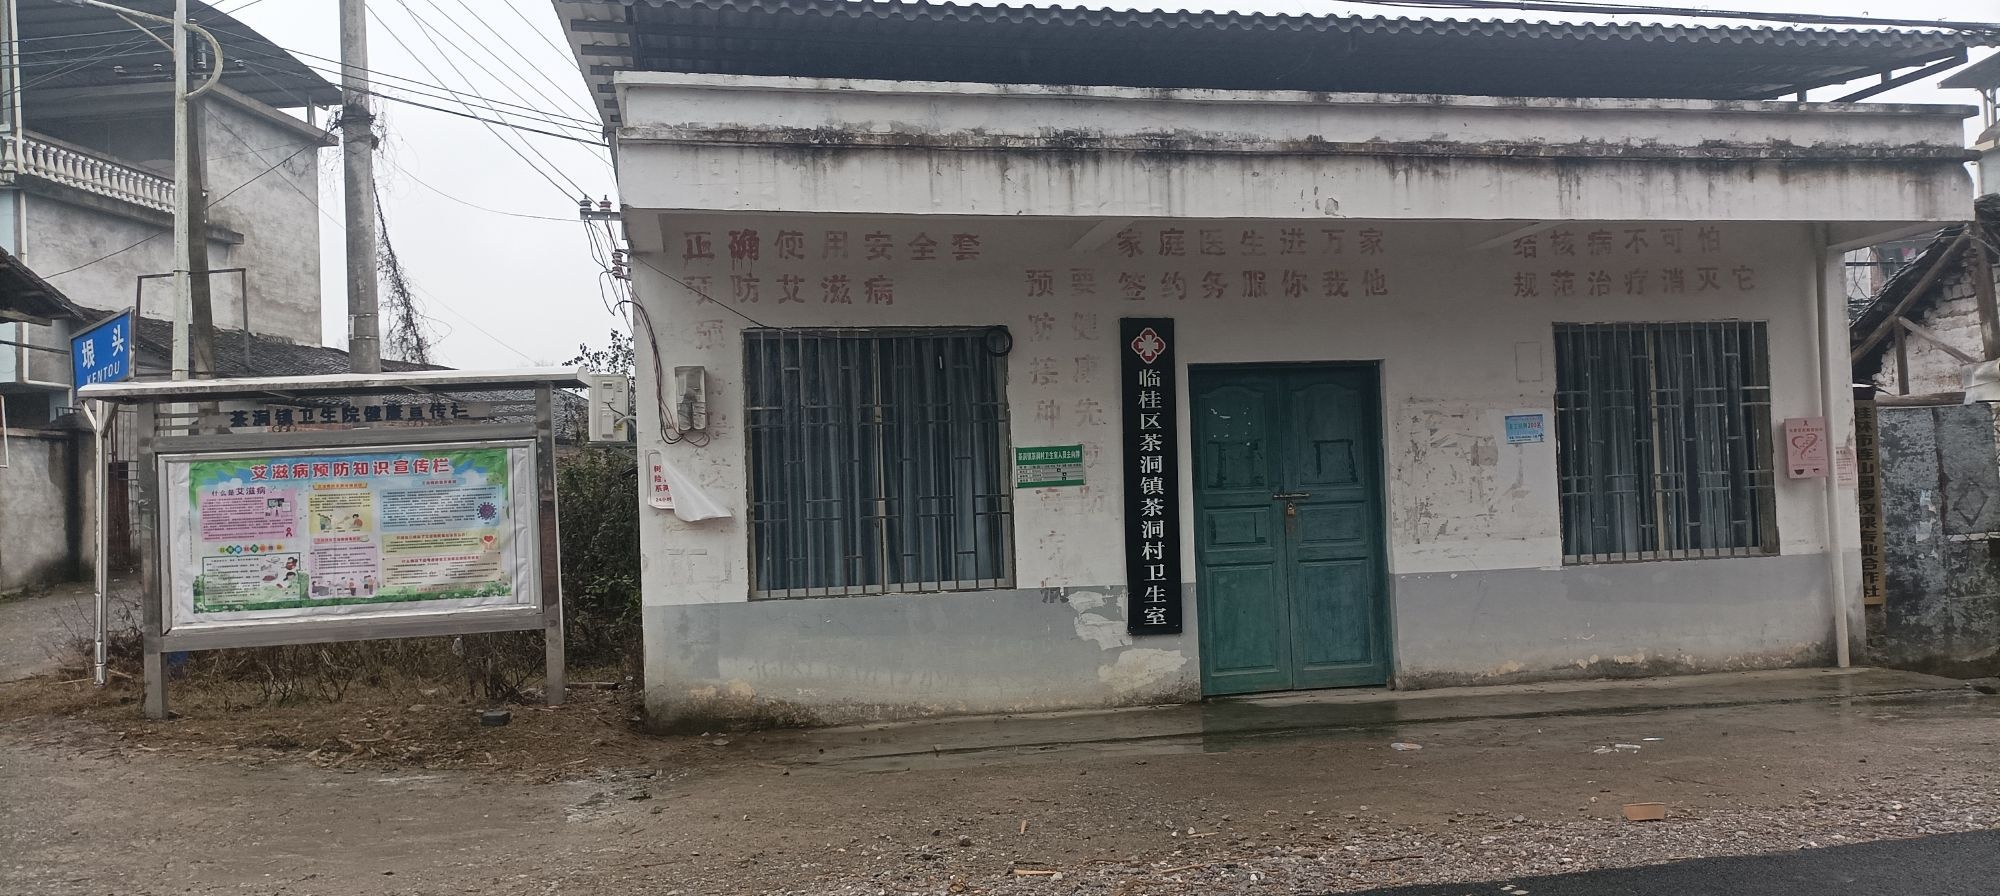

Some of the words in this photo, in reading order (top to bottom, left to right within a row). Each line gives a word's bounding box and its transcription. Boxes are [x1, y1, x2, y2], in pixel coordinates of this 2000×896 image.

[681, 228, 980, 261] 正确使用安全套
[1117, 226, 1386, 258] 家庭医生进万家
[1512, 226, 1722, 258] 结核病不可怕
[684, 273, 895, 306] 预防艾滋病
[1117, 268, 1389, 301] 签约务服你我他
[1512, 264, 1757, 298] 规范治疗消灭它
[81, 324, 125, 369] 垠头
[230, 402, 470, 428] 茶洞镇卫生院健康宣传栏
[251, 457, 451, 481] 艾滋病预防知识宣传栏
[1138, 368, 1168, 626] 临桂区茶洞镇茶洞村卫生室
